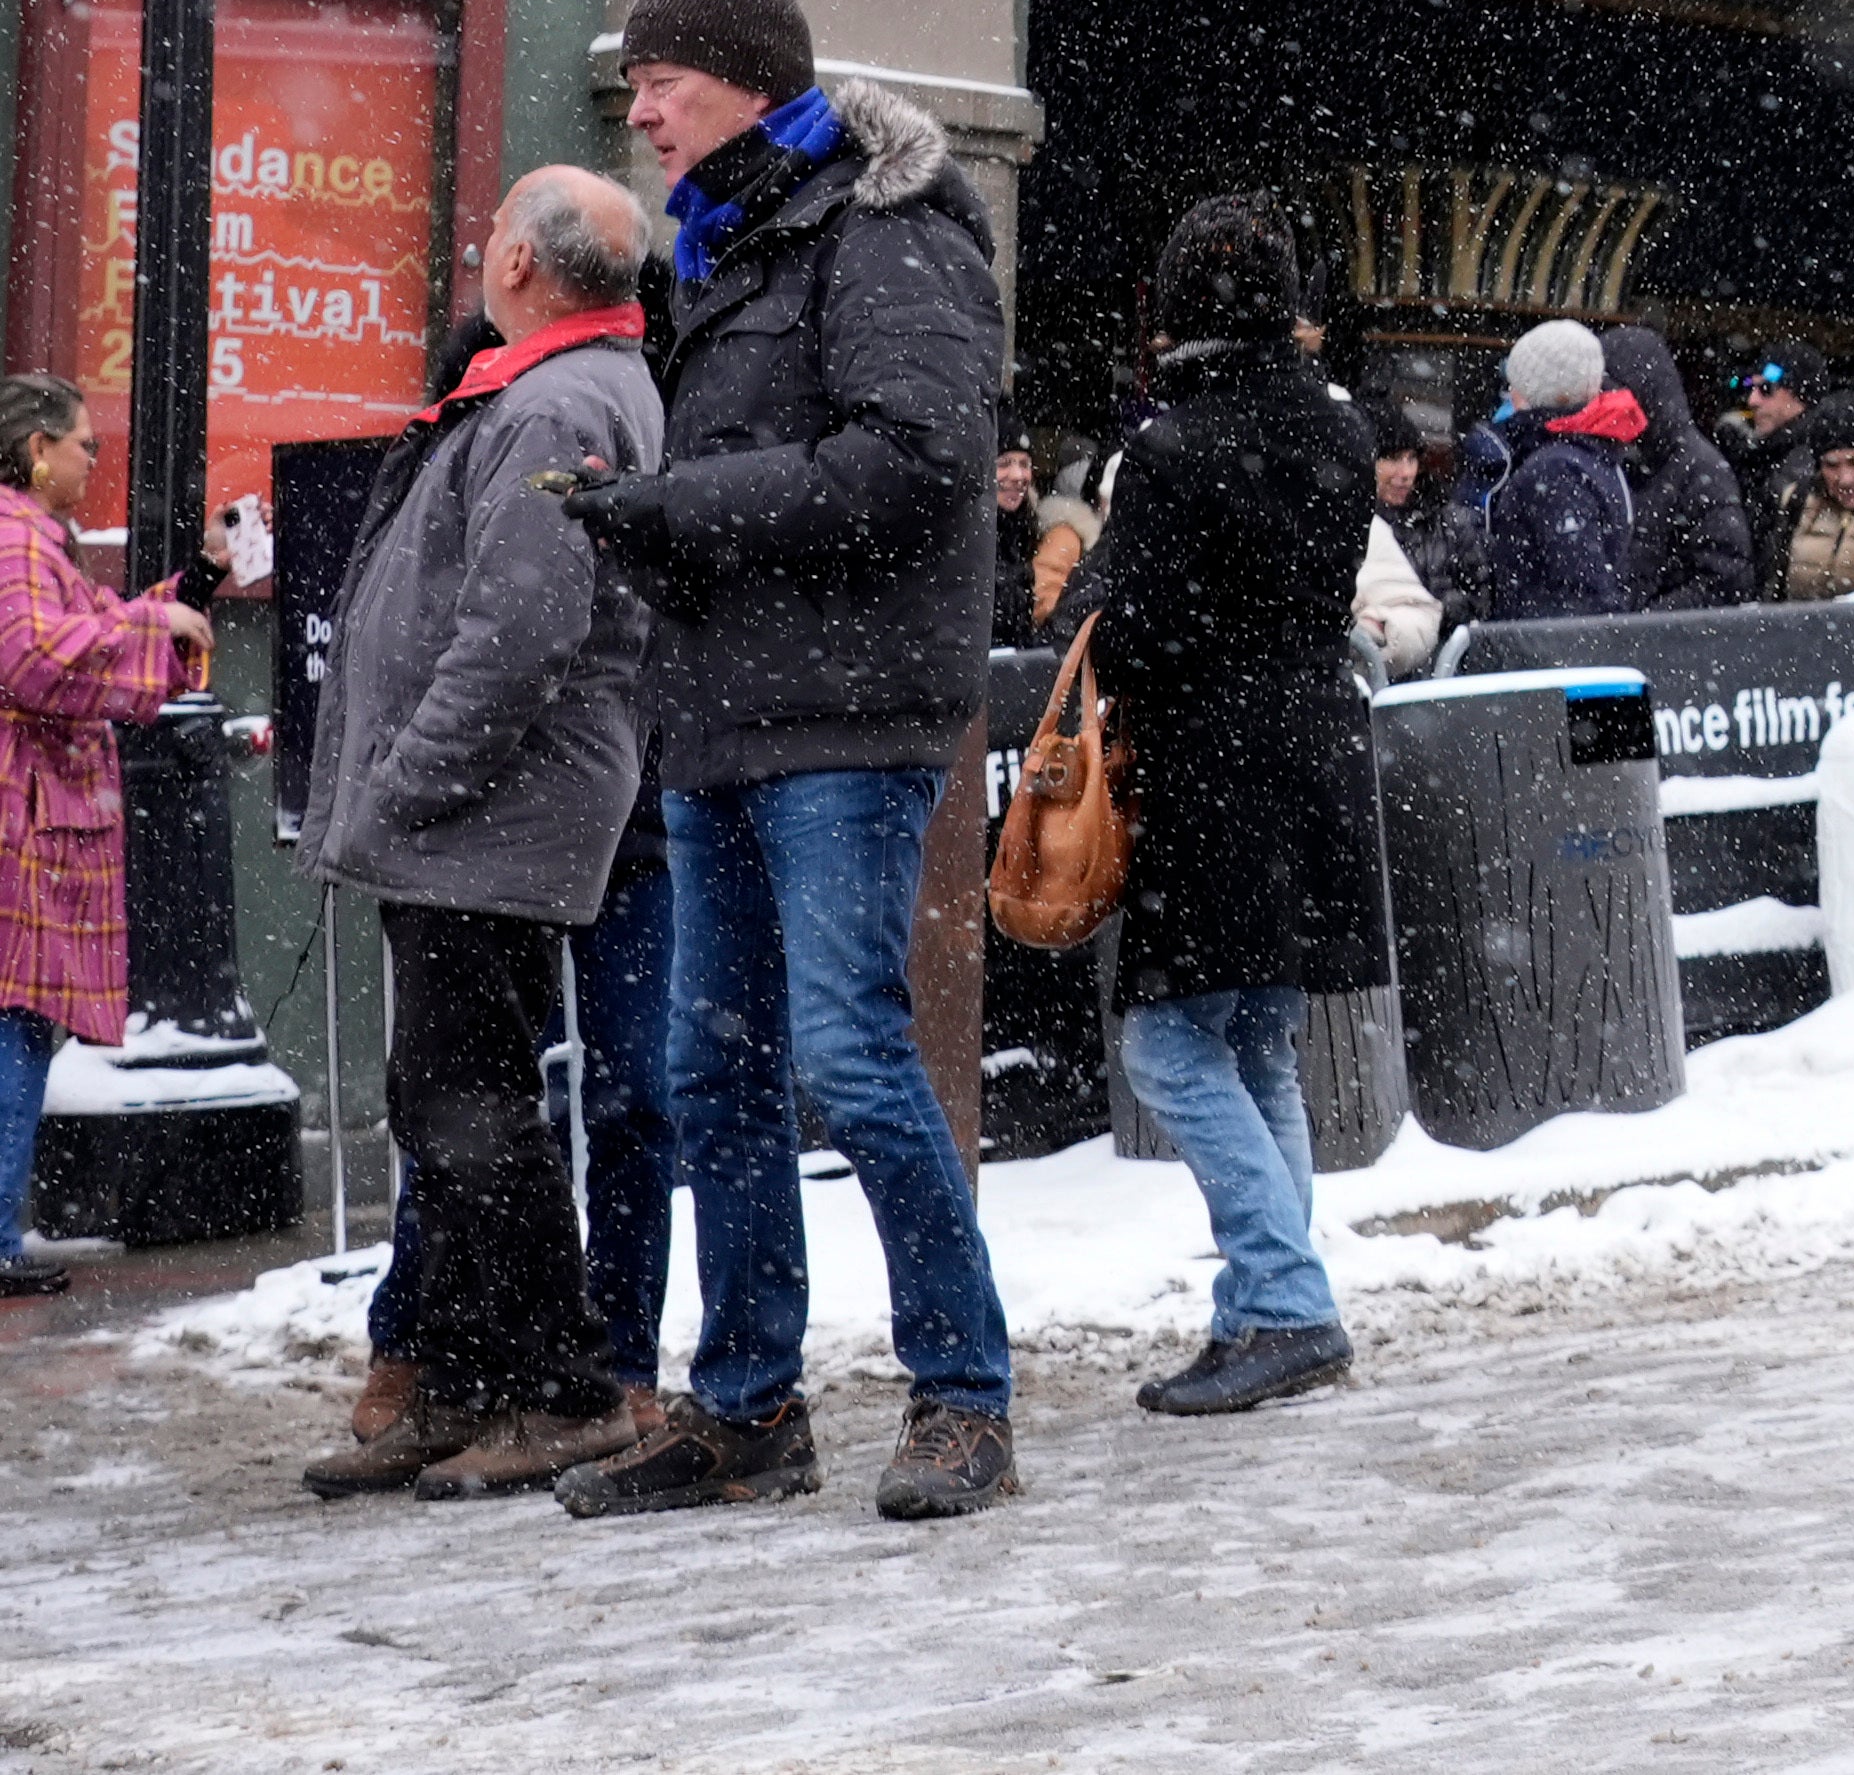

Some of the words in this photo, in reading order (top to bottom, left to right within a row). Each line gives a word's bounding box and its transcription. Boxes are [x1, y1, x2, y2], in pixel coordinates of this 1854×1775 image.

[106, 119, 394, 196] Sdance
[104, 256, 382, 328] Ftival
[98, 328, 245, 388] 25
[305, 612, 332, 645] Do
[1732, 685, 1821, 749] film
